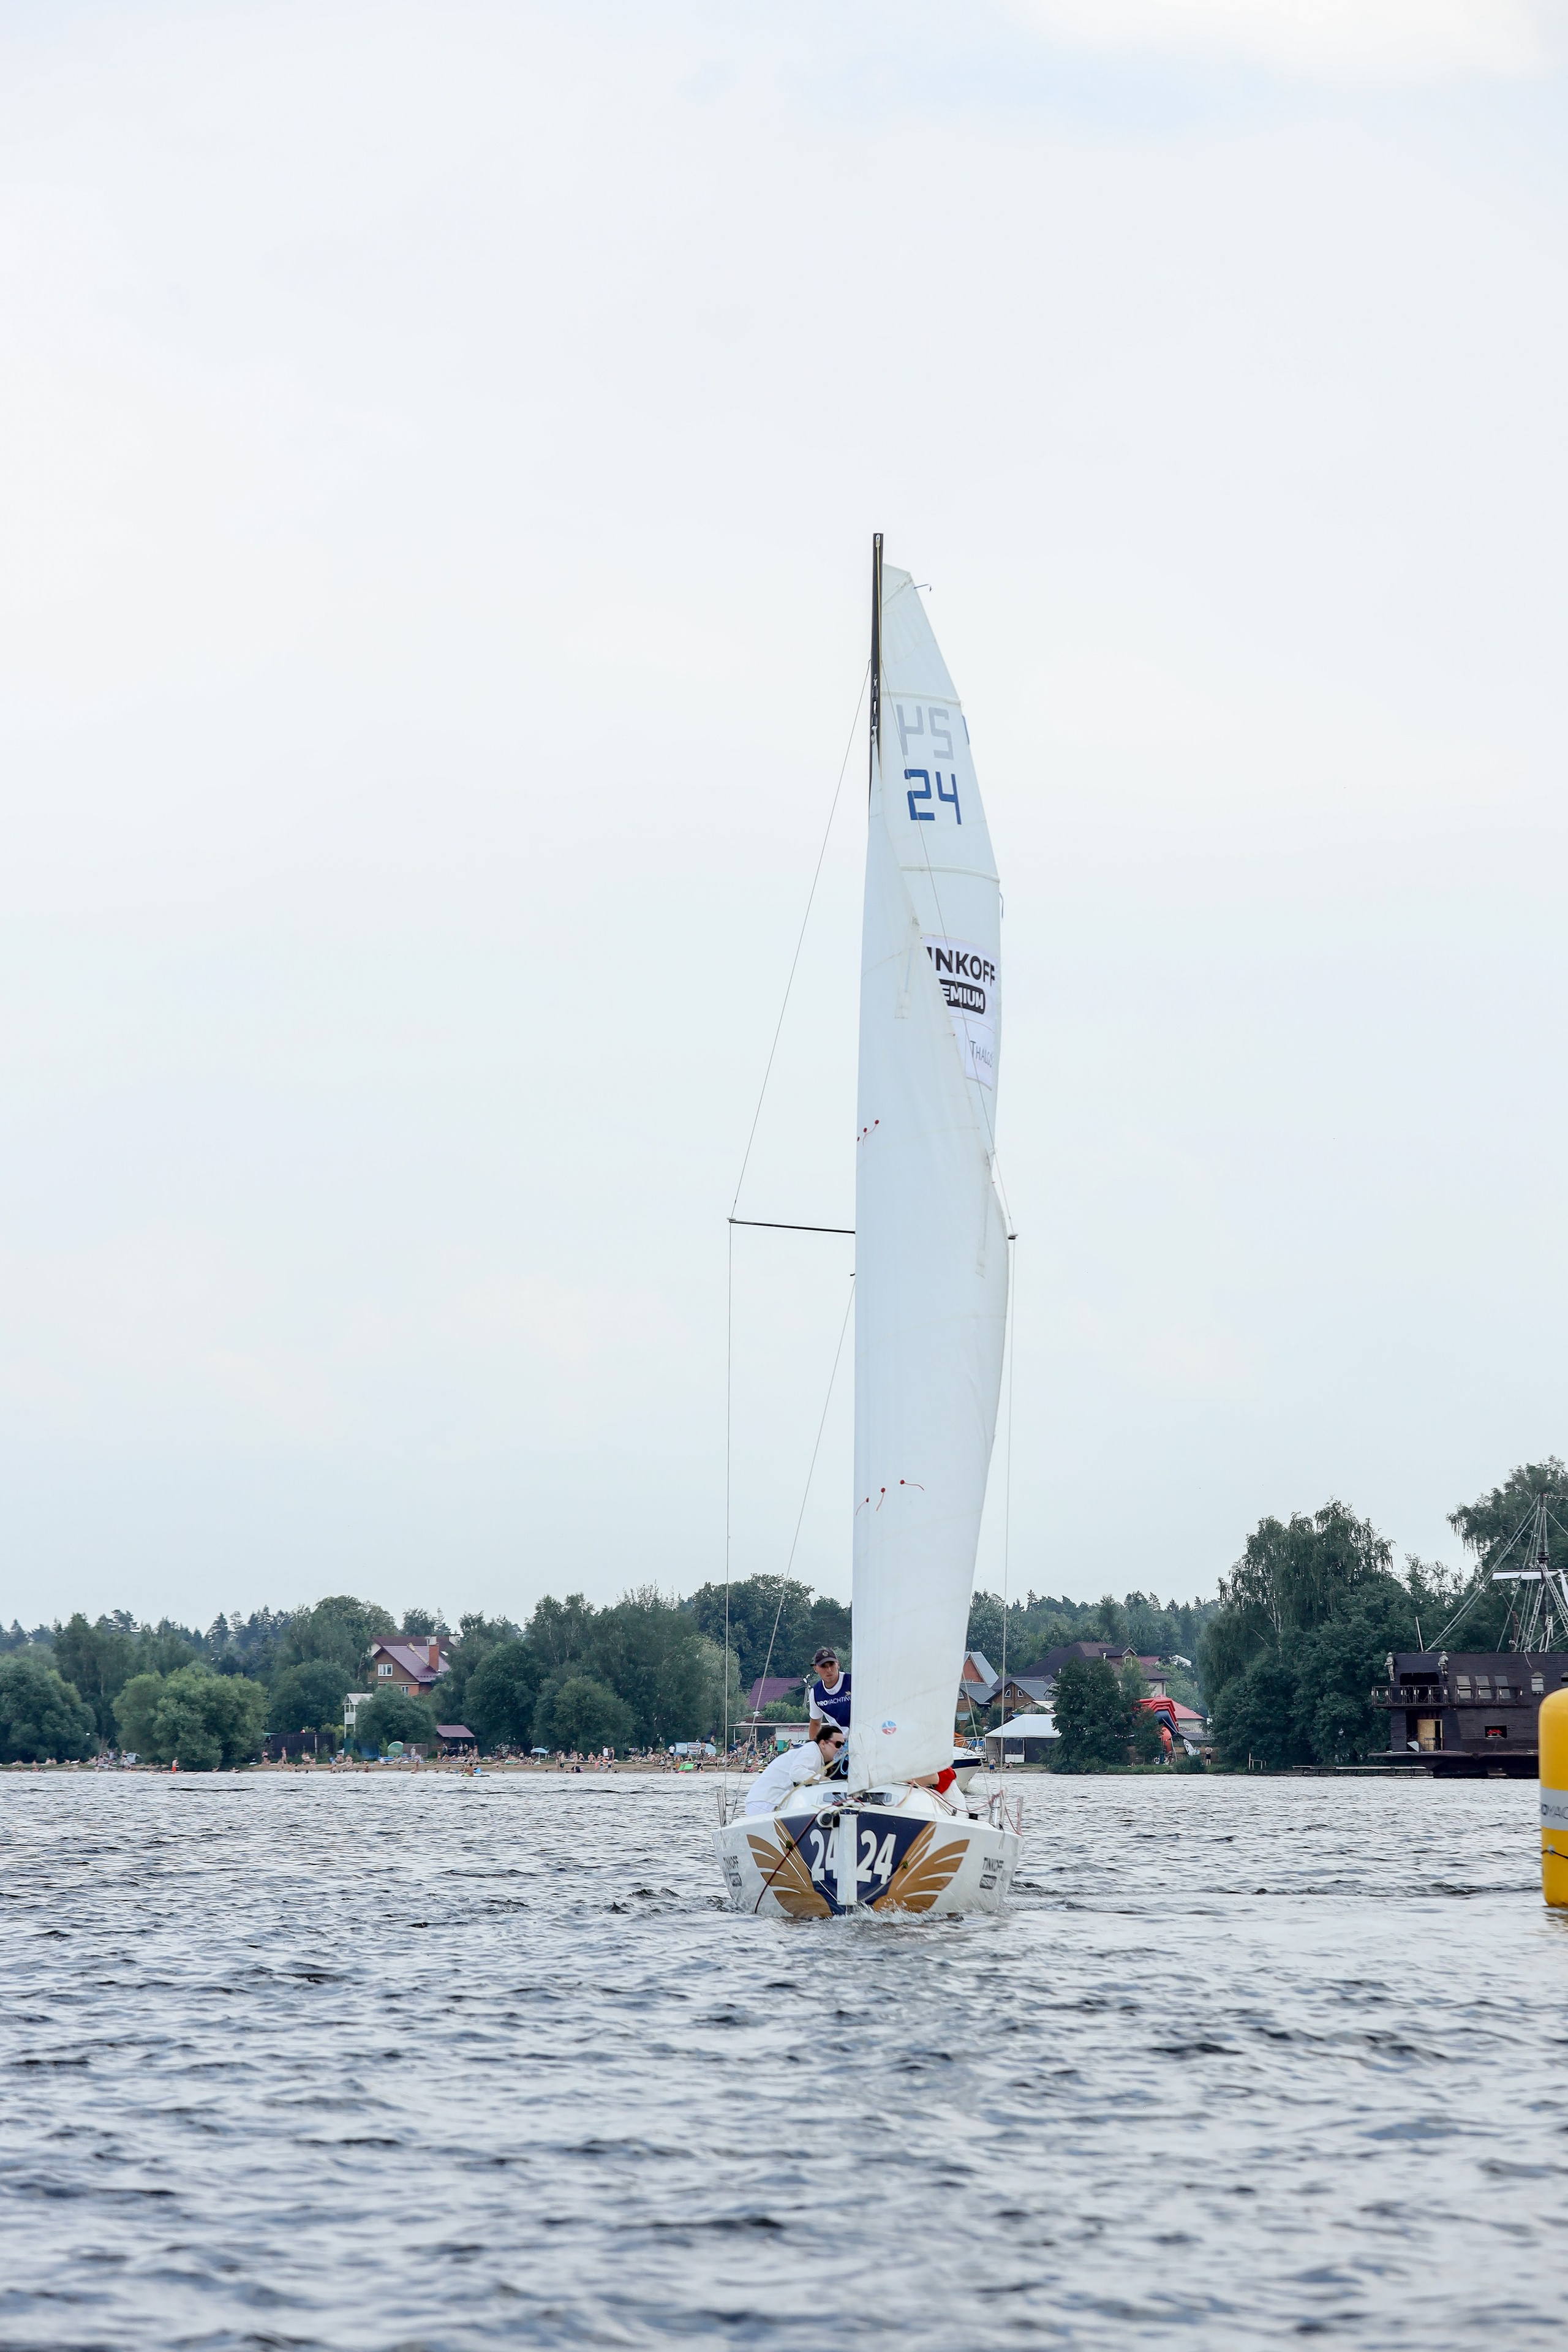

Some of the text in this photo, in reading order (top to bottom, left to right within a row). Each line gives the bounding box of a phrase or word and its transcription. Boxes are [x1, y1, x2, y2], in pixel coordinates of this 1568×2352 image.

[904, 769, 962, 825] 24
[810, 1828, 839, 1882] 24
[857, 1829, 897, 1885] 24
